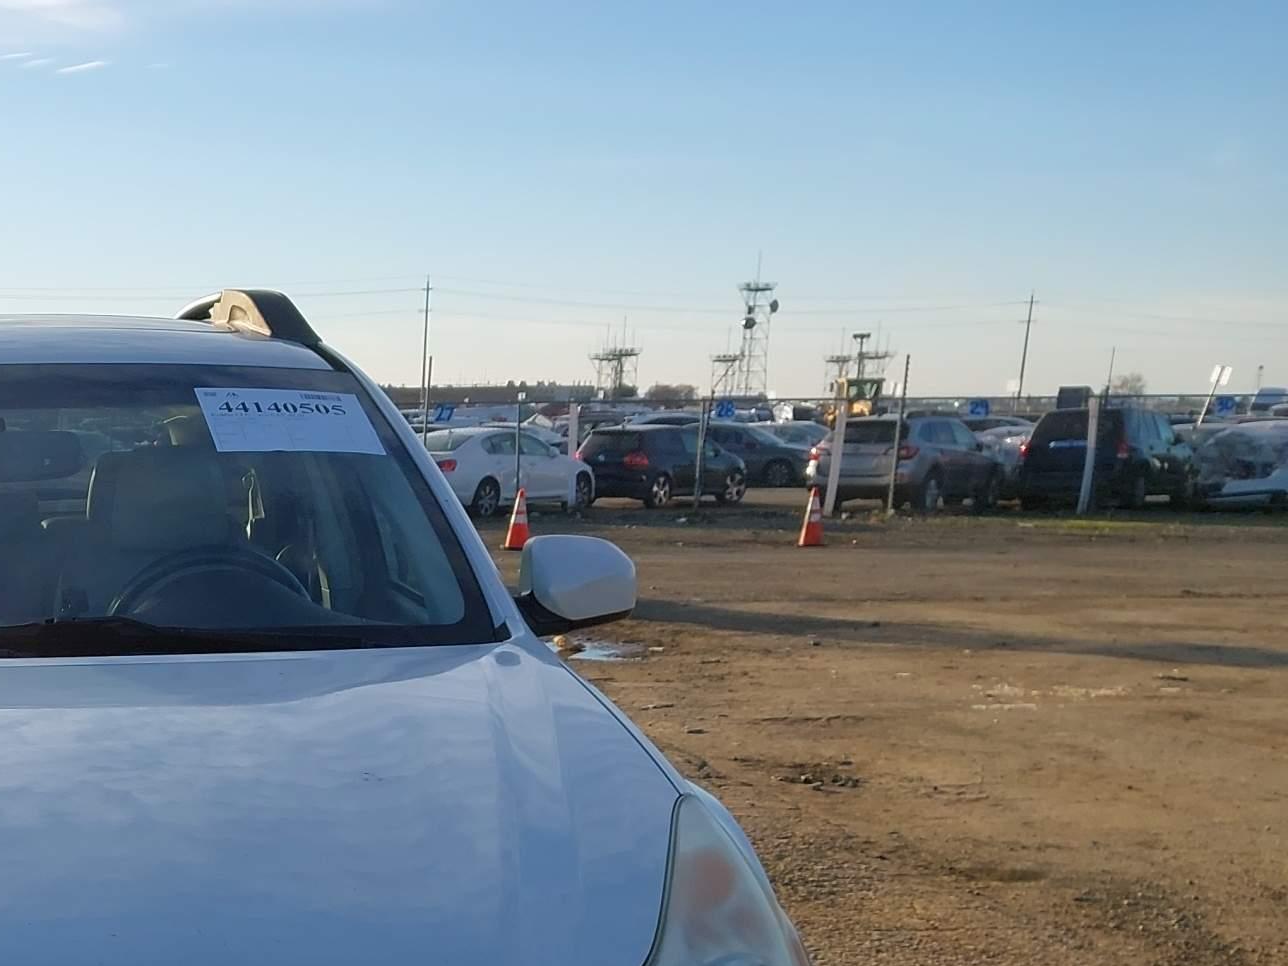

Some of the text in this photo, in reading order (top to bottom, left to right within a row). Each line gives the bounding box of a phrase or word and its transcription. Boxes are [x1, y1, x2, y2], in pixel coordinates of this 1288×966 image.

[219, 401, 346, 416] 44140505
[434, 404, 455, 421] 27
[717, 401, 736, 418] 28
